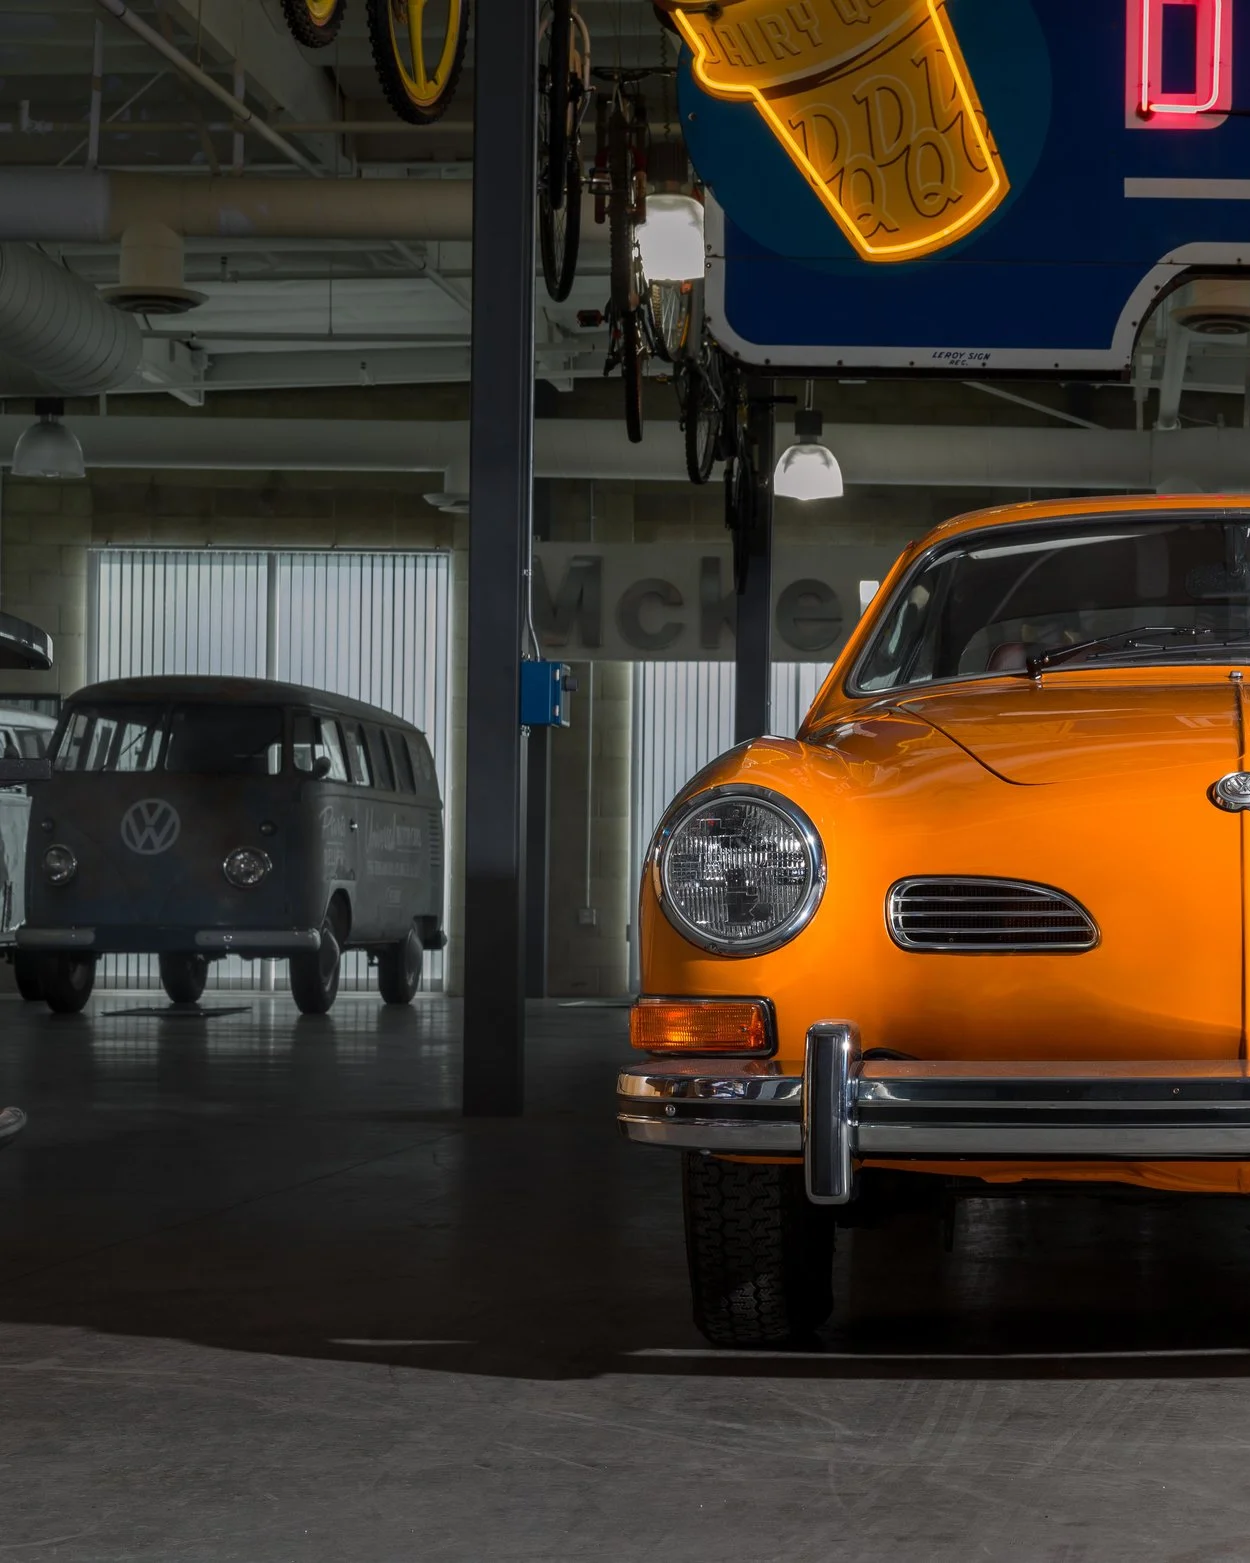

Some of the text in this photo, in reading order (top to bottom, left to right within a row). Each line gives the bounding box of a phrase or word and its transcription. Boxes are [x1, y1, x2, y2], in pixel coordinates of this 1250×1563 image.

[697, 5, 823, 67] DAIRY
[932, 351, 992, 361] LEROY SIGN
[122, 799, 181, 855] VW
